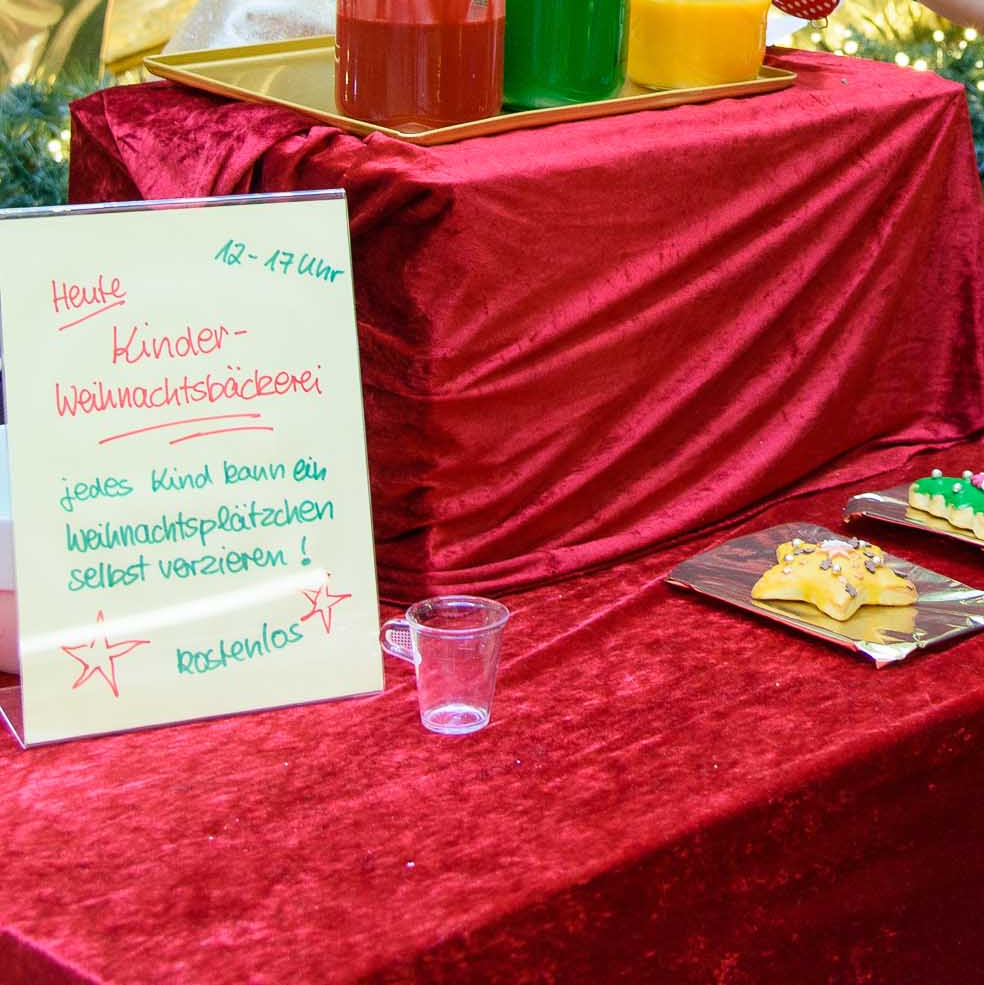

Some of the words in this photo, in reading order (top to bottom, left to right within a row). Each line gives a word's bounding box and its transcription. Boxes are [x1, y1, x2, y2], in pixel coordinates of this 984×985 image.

[297, 252, 345, 283] Uhr
[51, 274, 127, 313] Heute
[112, 321, 248, 364] Kinder-
[55, 364, 323, 417] Weihnachtsbäckerei
[59, 477, 133, 512] jedes
[151, 464, 213, 493] Kind
[223, 460, 285, 485] kann
[292, 456, 328, 483] ein
[65, 498, 335, 554] Weihnachtsplätzchen
[67, 554, 152, 592] selbst
[176, 622, 304, 675] kostenlos
